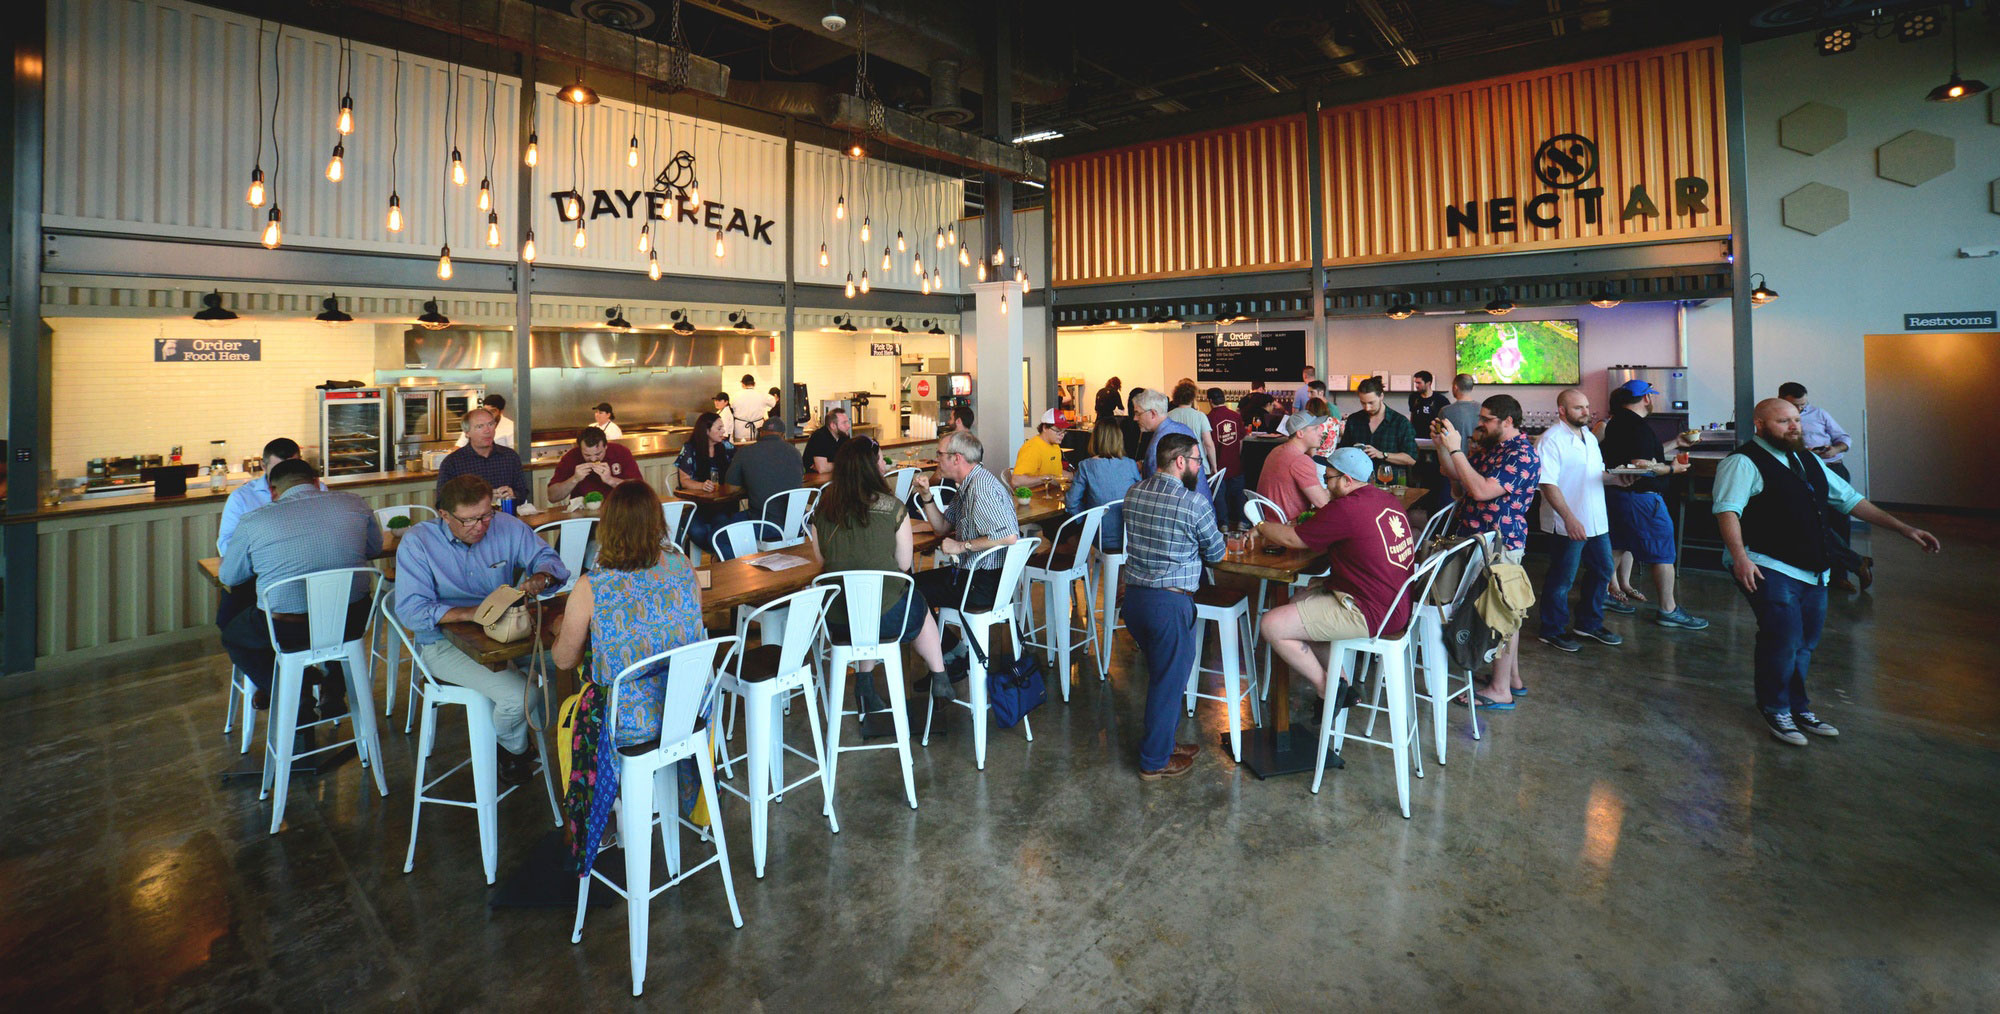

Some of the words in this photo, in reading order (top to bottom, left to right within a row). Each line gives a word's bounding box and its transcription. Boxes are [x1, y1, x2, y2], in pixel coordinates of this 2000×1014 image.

[1446, 176, 1710, 237] NECTAR
[1908, 317, 1993, 327] Restrooms
[1229, 332, 1253, 341] Order
[192, 339, 243, 351] Order
[873, 343, 886, 351] Pick
[886, 343, 894, 352] Up
[183, 351, 216, 361] Food
[218, 351, 251, 361] Here
